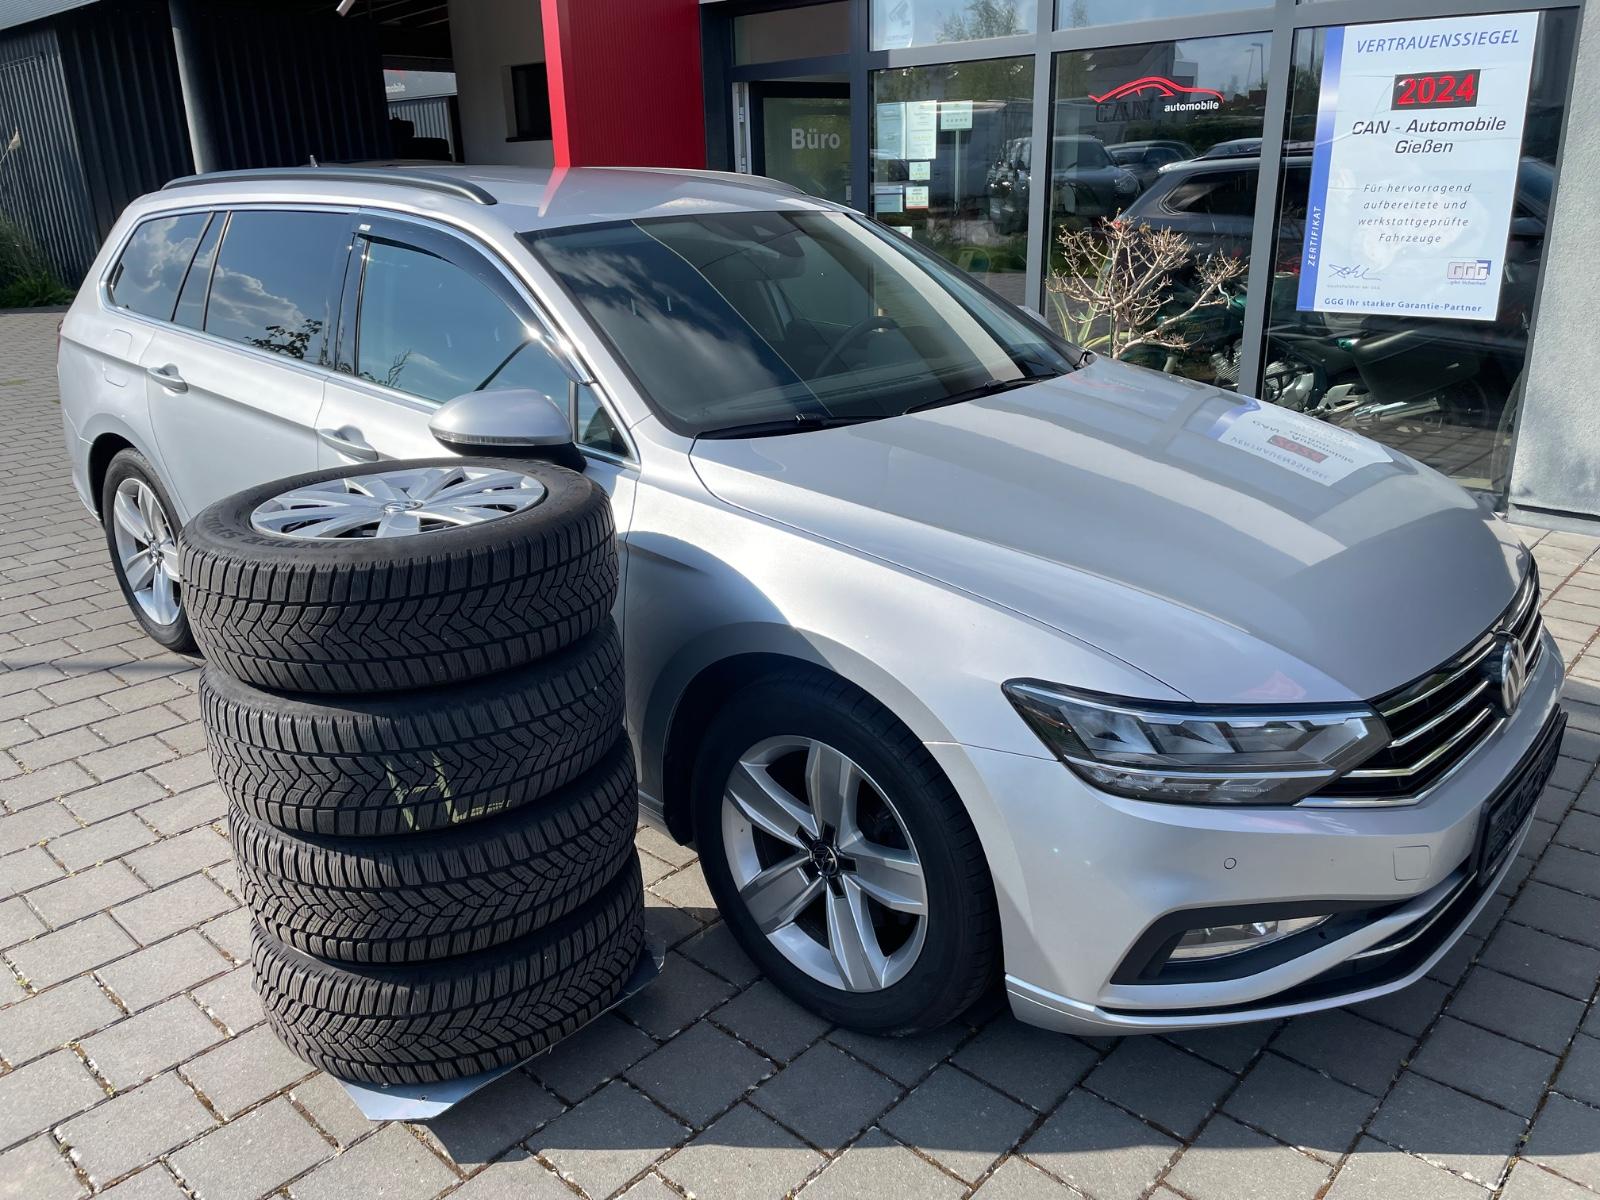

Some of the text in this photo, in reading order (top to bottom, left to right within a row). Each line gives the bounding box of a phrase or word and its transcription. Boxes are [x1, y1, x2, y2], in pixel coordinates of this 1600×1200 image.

[1356, 29, 1520, 53] VERTRAUENSSIEGEL
[1397, 74, 1476, 105] 2024
[1164, 101, 1220, 112] automobile
[1352, 121, 1391, 135] CAN
[1406, 117, 1507, 134] Automobile
[791, 128, 841, 150] Büro
[1394, 139, 1454, 154] Gießen
[1364, 183, 1472, 195] Für hervorragend
[1363, 200, 1467, 211] aufbereitete und
[1358, 217, 1469, 230] werkstattgeprüfte
[1308, 206, 1321, 266] ZERTIFIKAT
[1379, 234, 1442, 244] Fahrzeuge
[1325, 298, 1344, 306] GGG
[1363, 300, 1395, 308] starker
[1398, 302, 1482, 312] Garantie-Partner
